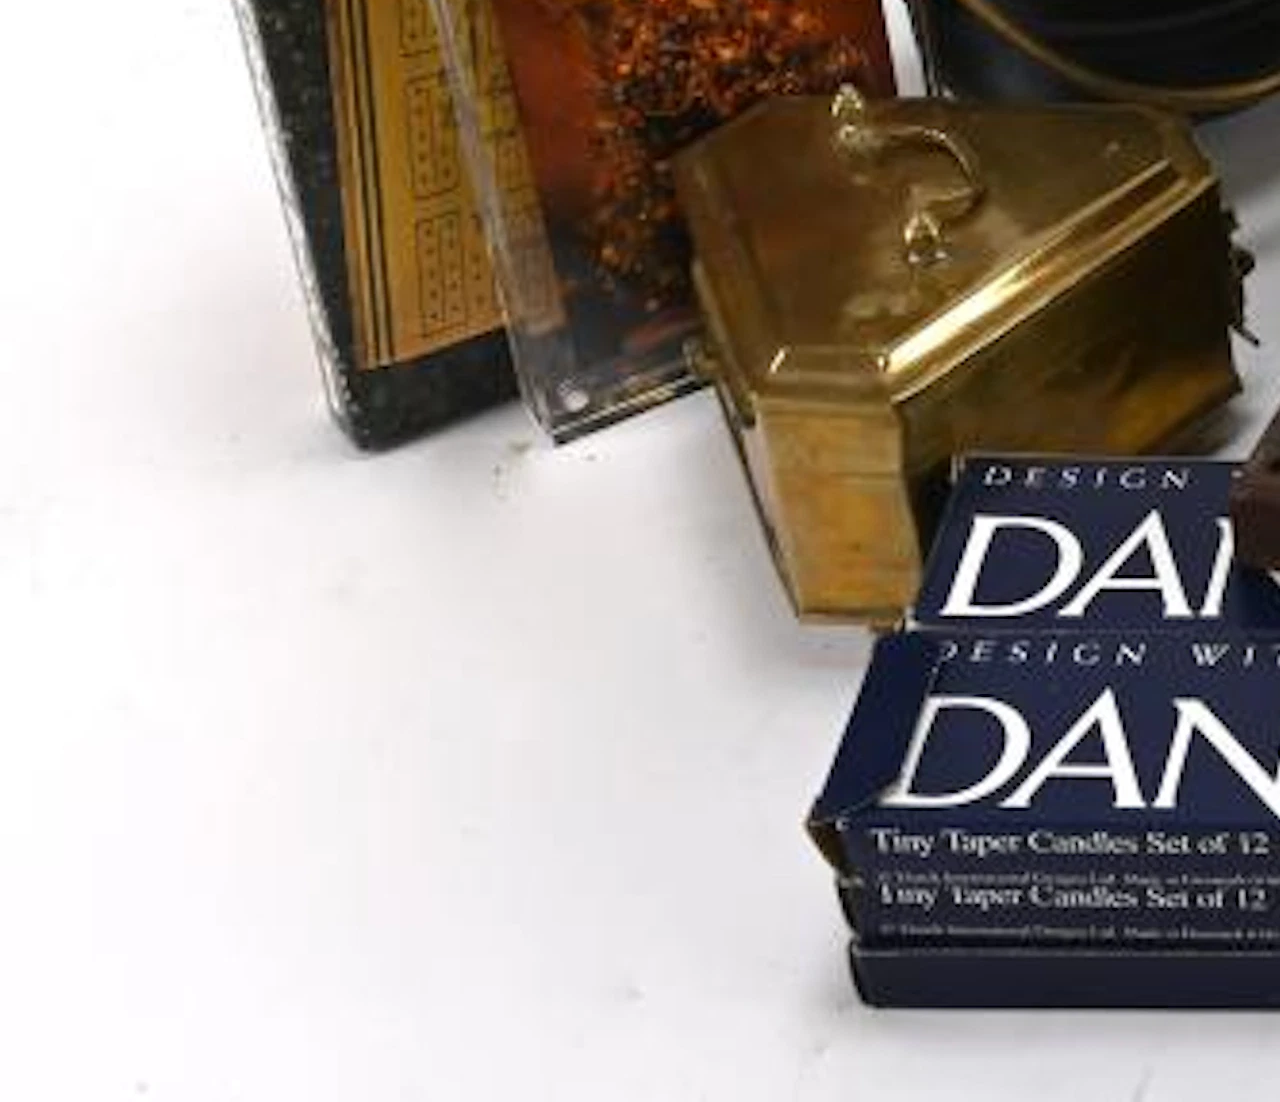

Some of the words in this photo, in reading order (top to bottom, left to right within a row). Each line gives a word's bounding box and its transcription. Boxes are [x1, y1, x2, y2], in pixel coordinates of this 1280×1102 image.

[980, 464, 1195, 490] DESIGN
[869, 827, 935, 858] Tiny
[941, 828, 1022, 858] Taper
[1027, 830, 1139, 856] Candles
[1145, 830, 1191, 855] Set
[1197, 833, 1230, 855] of
[1239, 832, 1271, 855] 12
[877, 882, 938, 911] Tiny
[948, 884, 1022, 912] Taper
[1028, 884, 1139, 910] Candles
[1145, 887, 1191, 910] Set
[1196, 888, 1225, 910] of
[1236, 887, 1269, 911] 12
